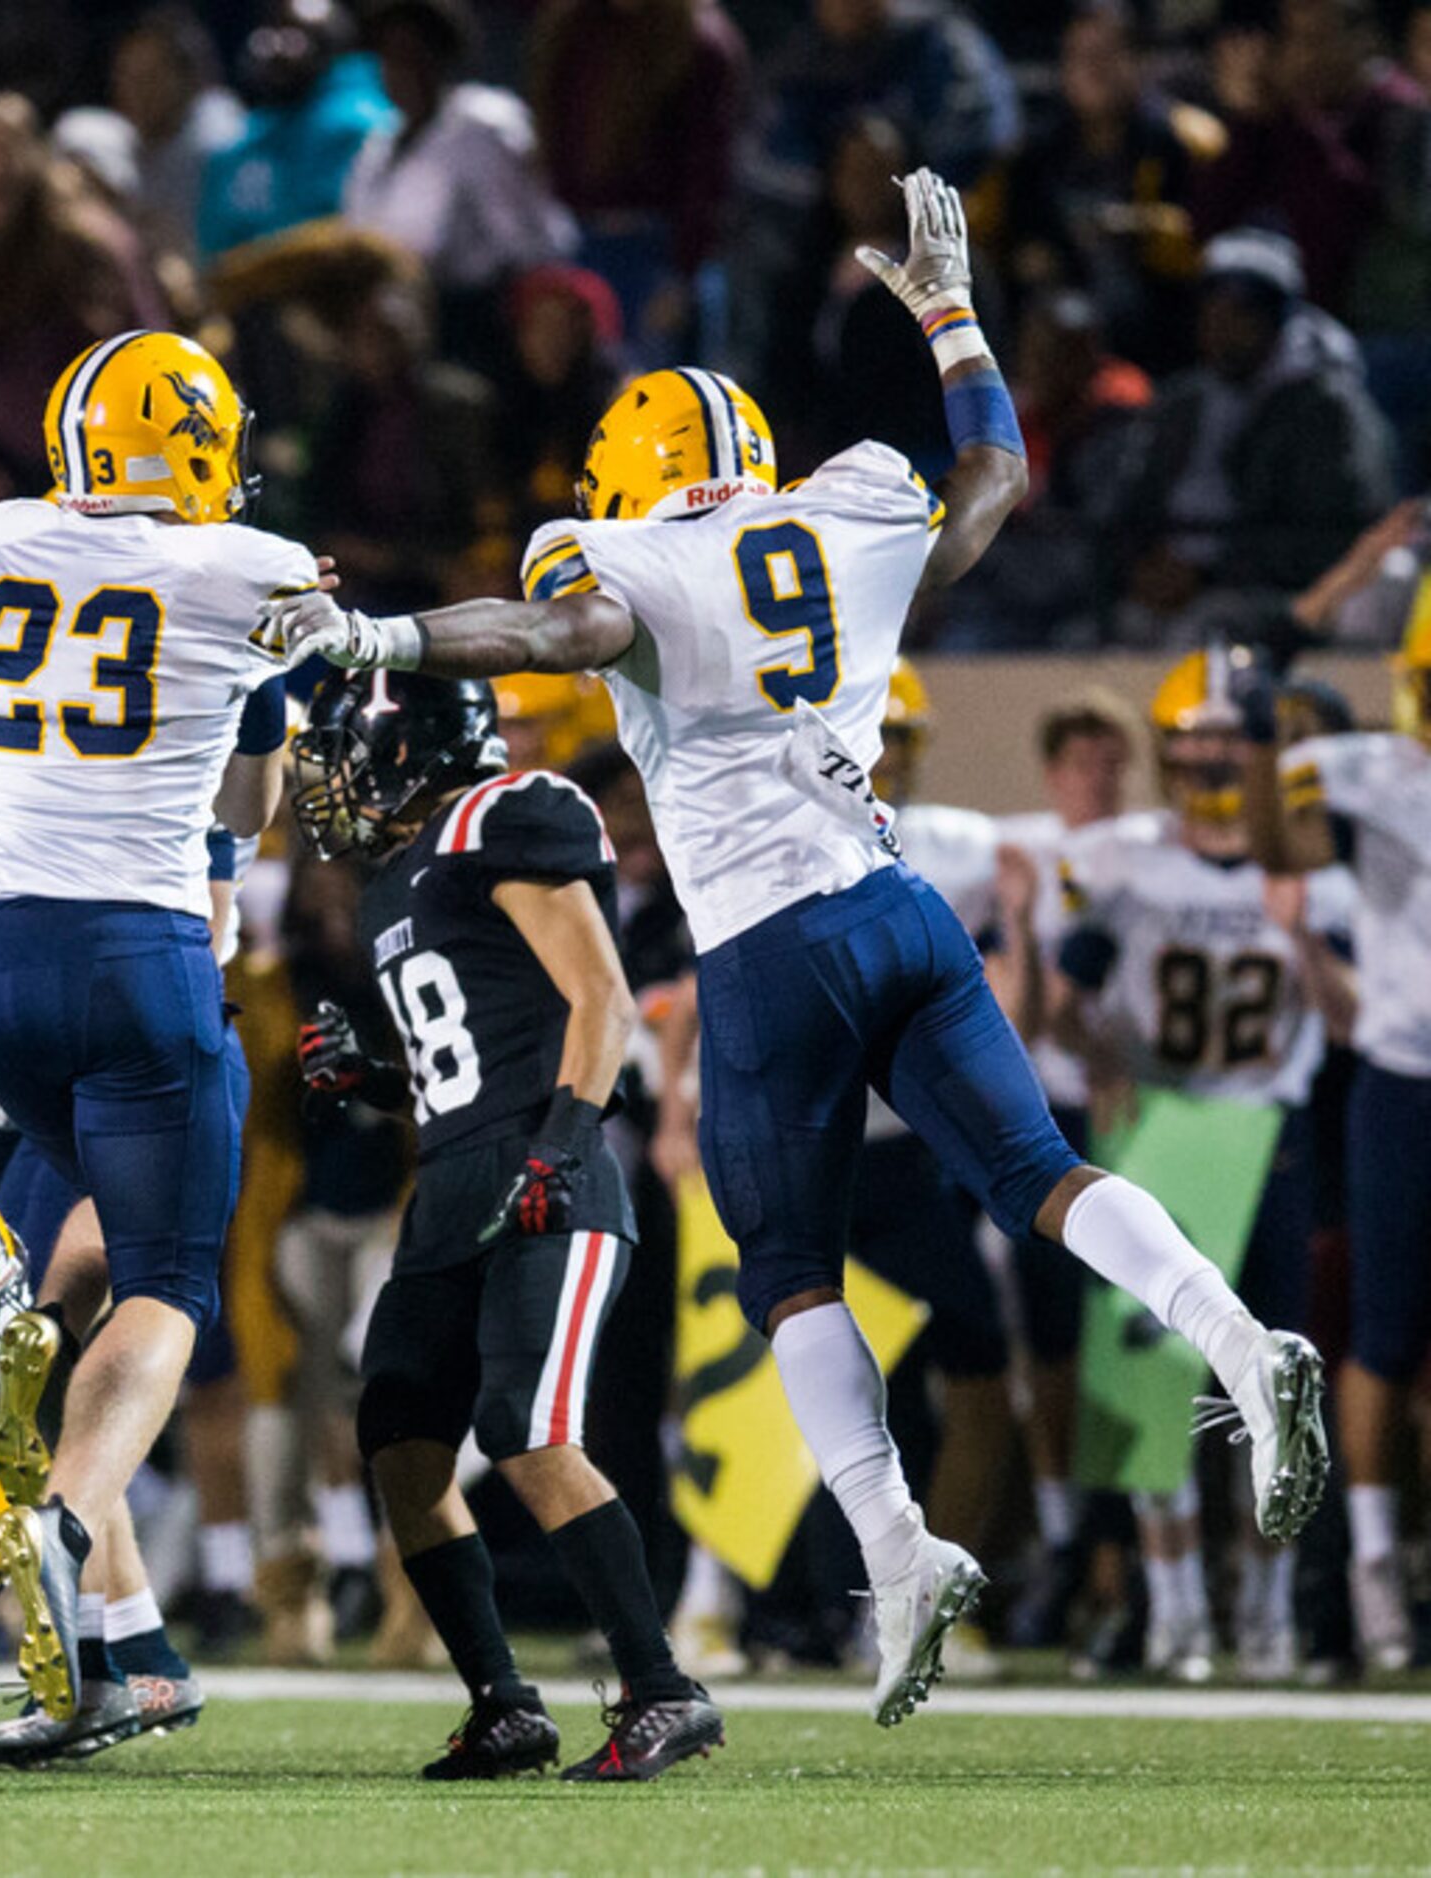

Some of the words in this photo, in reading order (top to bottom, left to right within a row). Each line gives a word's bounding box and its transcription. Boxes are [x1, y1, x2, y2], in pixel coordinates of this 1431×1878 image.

[92, 448, 116, 485] 3
[730, 518, 844, 713] 9
[377, 949, 483, 1127] 18
[1153, 945, 1283, 1068] 82
